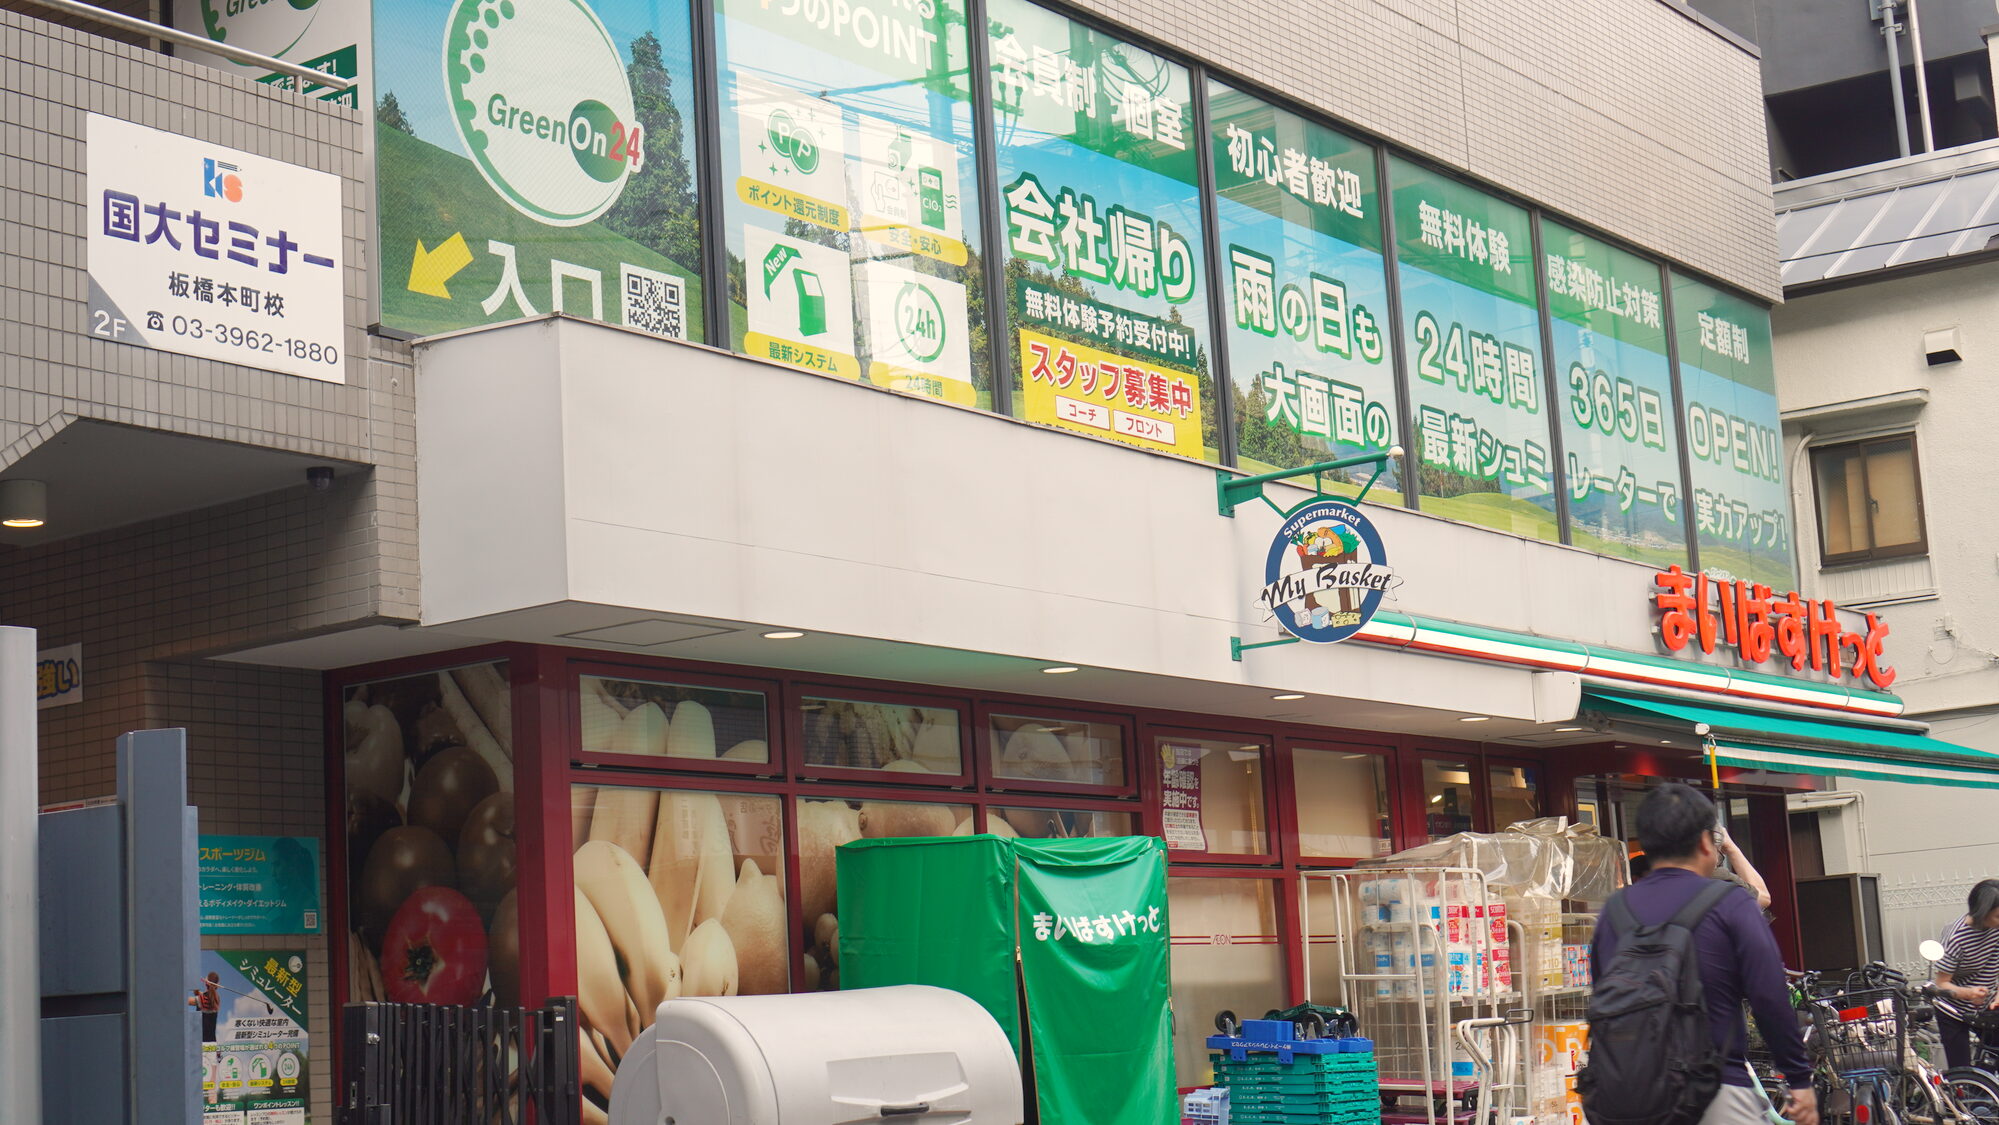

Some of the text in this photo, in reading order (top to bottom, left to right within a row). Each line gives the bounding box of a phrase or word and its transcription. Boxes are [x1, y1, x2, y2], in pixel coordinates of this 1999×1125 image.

[994, 34, 1186, 151] 会員制 個室
[1226, 122, 1364, 219] 初心者歓迎
[103, 188, 335, 275] 国大セミナー
[748, 185, 840, 227] ポイント還元制度
[765, 248, 788, 277] New
[1005, 175, 1194, 300] 会社帰り
[1418, 200, 1512, 276] 無料体験
[168, 271, 285, 319] 板橋本町校
[481, 239, 603, 321] 入口
[1230, 246, 1382, 362] 雨の日も
[1547, 254, 1661, 329] 感染防止対策
[94, 309, 127, 338] 2F
[172, 315, 339, 366] 03-3962-1880
[904, 305, 937, 340] 24h
[1024, 287, 1190, 360] 無料体験予約受付中!
[1697, 311, 1750, 365] 定額制
[769, 341, 838, 373] 最新システム
[905, 374, 944, 398] 24時間
[1029, 341, 1194, 419] スタッフ募集中
[1415, 312, 1538, 413] 24時間
[1068, 403, 1098, 422] コーチ
[1126, 417, 1163, 439] フロント
[1263, 363, 1391, 448] 大画面の
[1568, 362, 1665, 451] 365日
[1420, 405, 1548, 492] 最新シュミ
[1689, 403, 1779, 483] OPEN!
[1569, 453, 1676, 522] レーターで
[1283, 507, 1361, 539] Supermarket
[1695, 490, 1788, 551] 実力アップ!
[1261, 563, 1392, 609] My Basket
[1655, 563, 1896, 688] まいばすけっと
[198, 847, 267, 862] スポーツジム
[1033, 904, 1161, 943] まいばすけっと
[239, 958, 302, 1015] シミュレーター
[264, 957, 303, 998] 最新型
